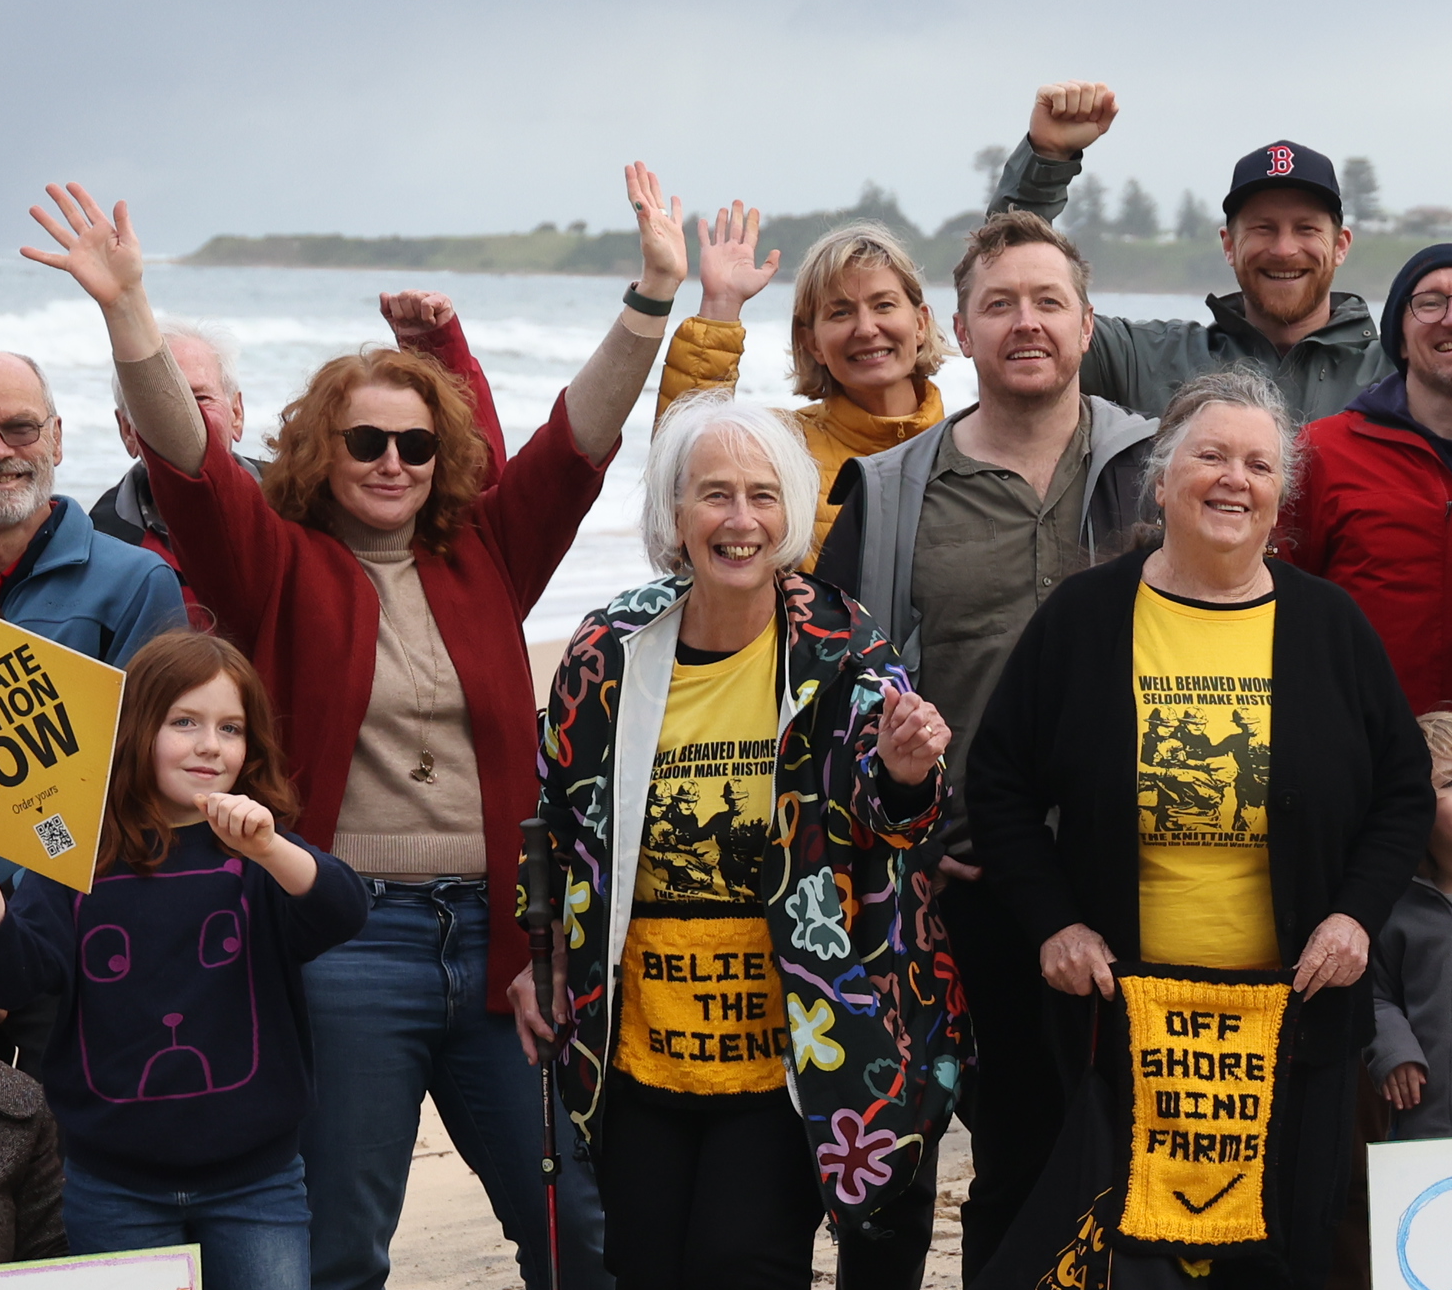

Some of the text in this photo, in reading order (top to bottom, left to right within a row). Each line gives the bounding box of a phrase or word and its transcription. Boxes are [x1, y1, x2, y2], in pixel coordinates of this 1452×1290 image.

[1267, 145, 1295, 176] B
[1138, 676, 1272, 693] WELL BEHAVED WOM
[1143, 693, 1272, 706] SELDOM MAKE HISTO
[678, 741, 735, 763] BEHAVED
[738, 738, 777, 760] WOME
[694, 762, 728, 778] MAKE
[732, 760, 775, 776] HISTOR
[12, 785, 59, 814] Order yours
[1139, 832, 1268, 842] THE KNITTING NA
[642, 950, 775, 983] BELIE
[693, 992, 768, 1022] THE
[1166, 1010, 1242, 1041] OFF
[649, 1027, 788, 1062] SCIENC
[1140, 1048, 1266, 1082] SHORE
[1155, 1090, 1260, 1121] WIND
[1147, 1129, 1260, 1164] FARMS
